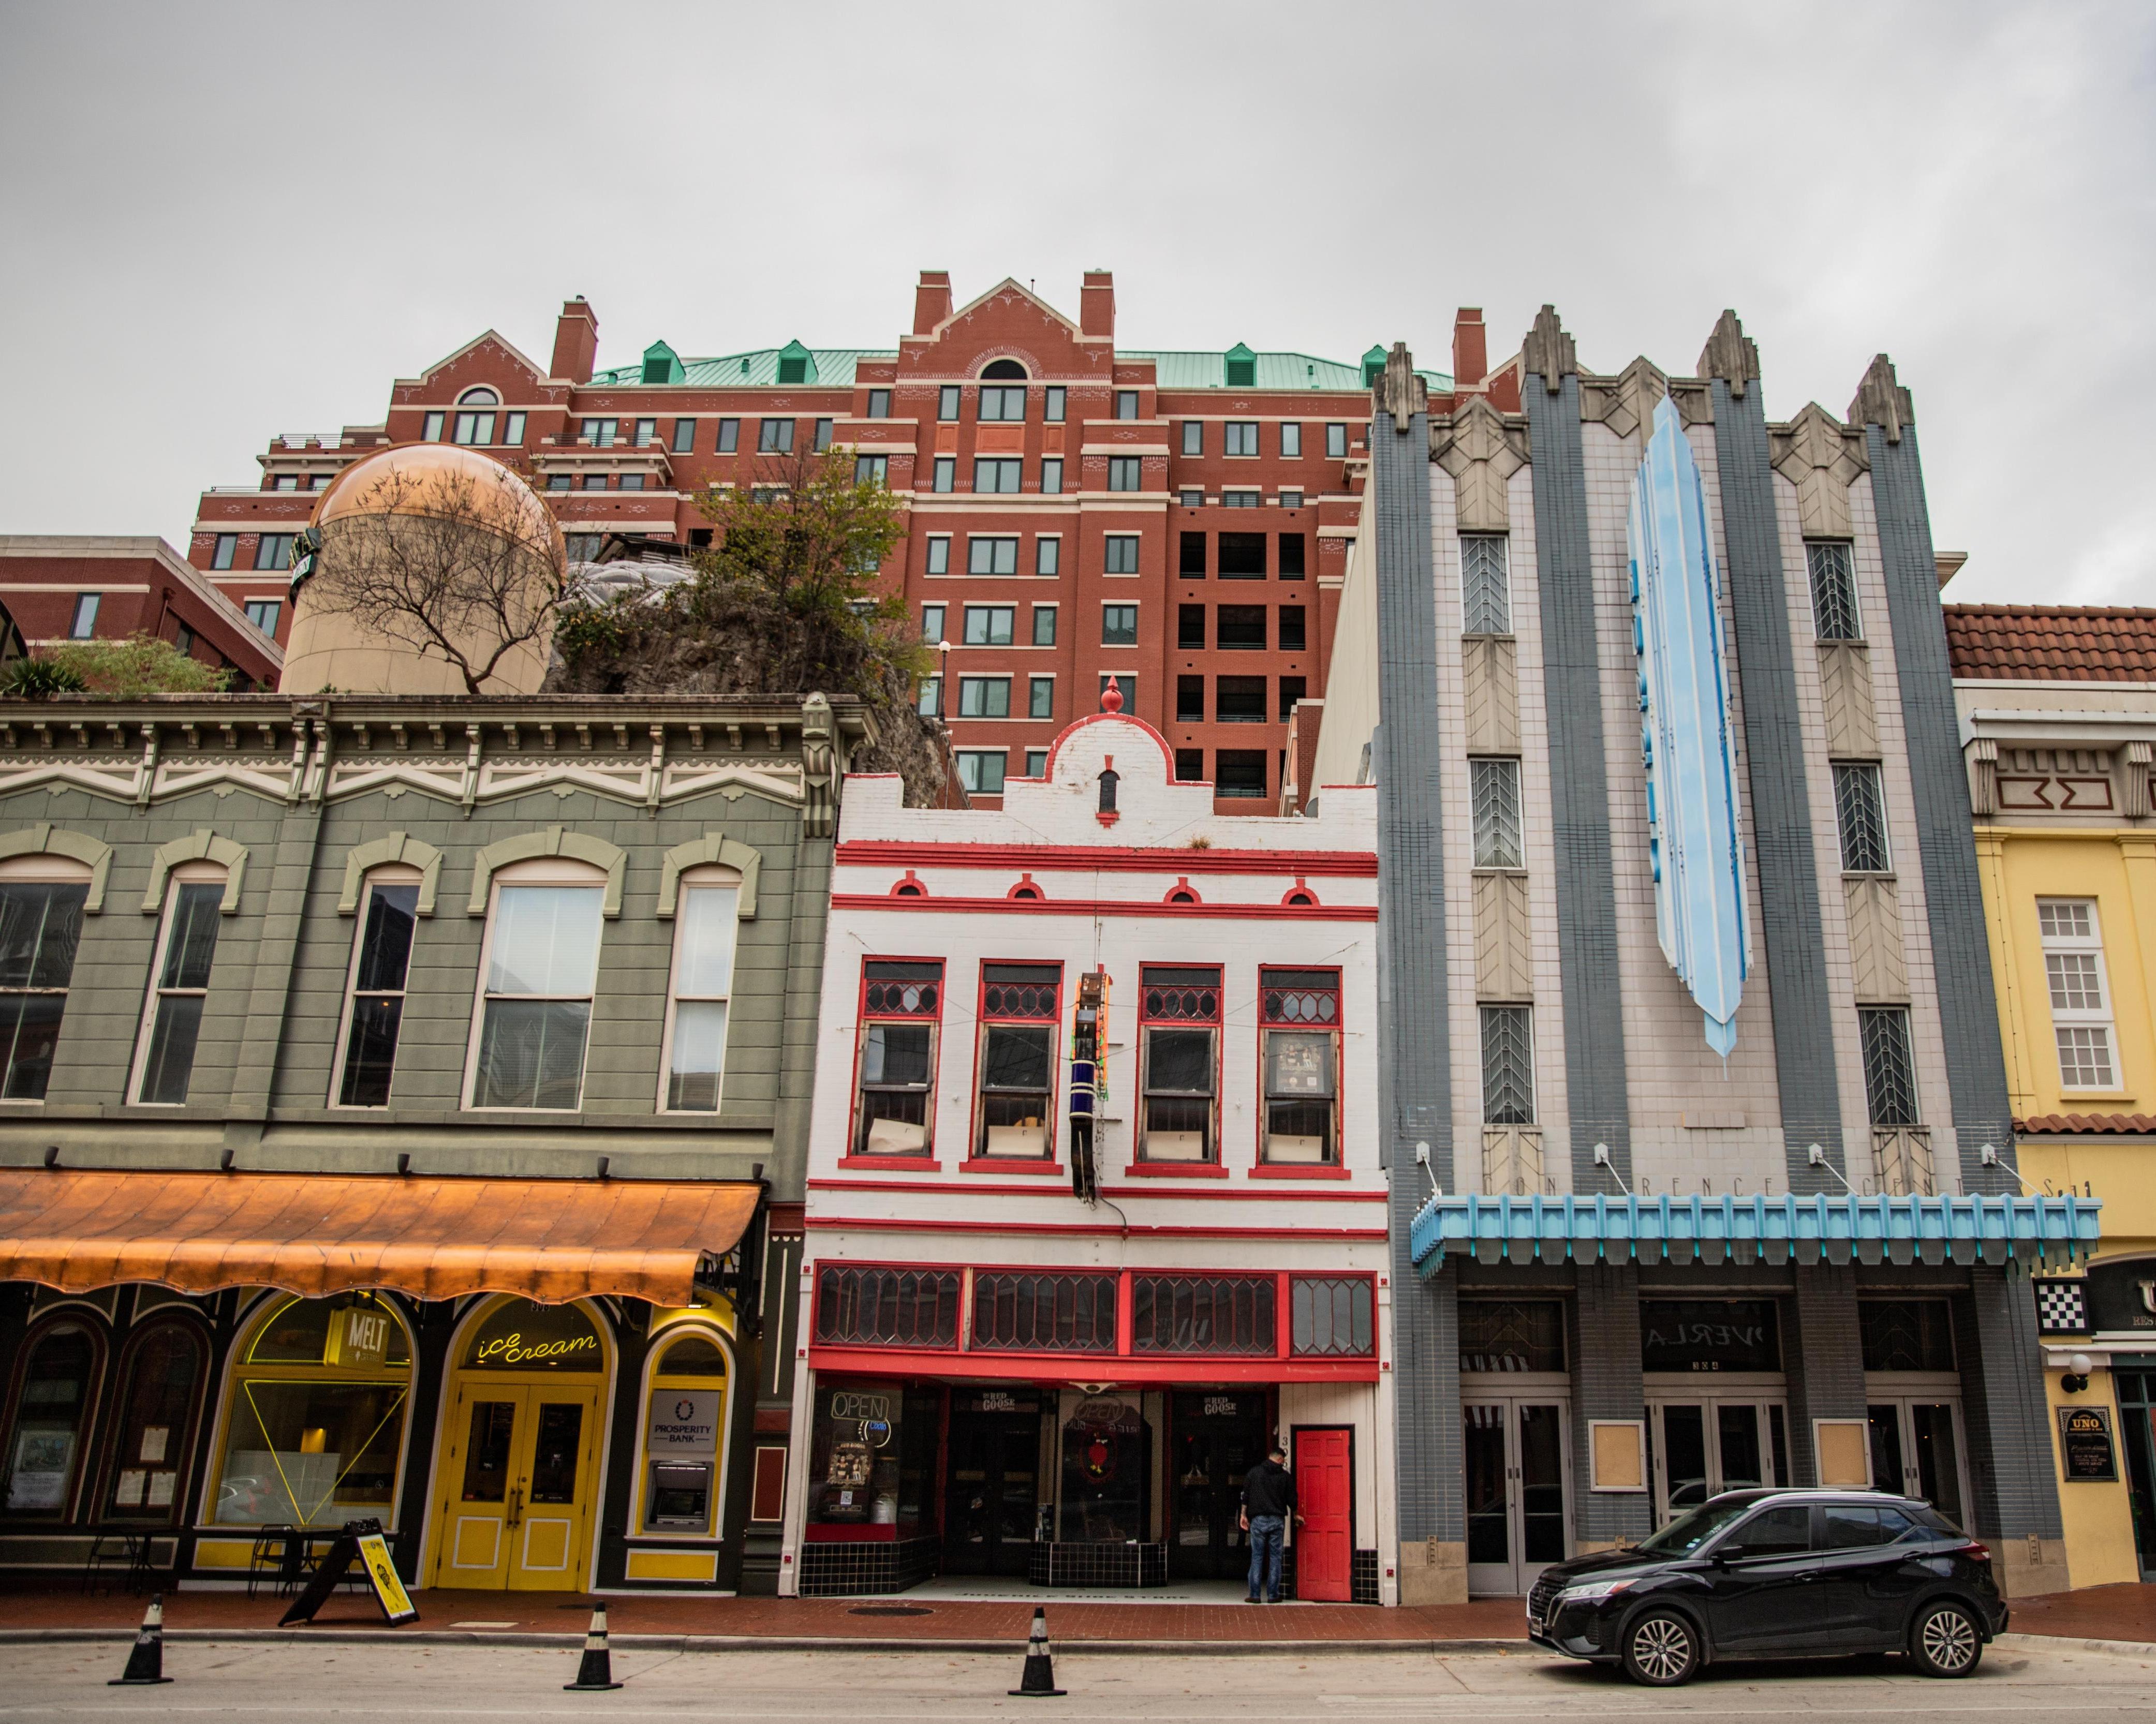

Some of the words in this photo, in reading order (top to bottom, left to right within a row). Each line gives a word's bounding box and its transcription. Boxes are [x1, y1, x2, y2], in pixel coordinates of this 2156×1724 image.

[349, 1313, 387, 1352] MELT
[479, 1333, 521, 1358] ice
[506, 1335, 597, 1363] cream
[834, 1394, 884, 1419] OPEN
[983, 1398, 1015, 1411] GOOSE
[1204, 1402, 1237, 1416] GOOSE
[654, 1424, 712, 1434] PROSPERITY
[2072, 1418, 2099, 1428] UNO
[669, 1434, 695, 1443] BANK
